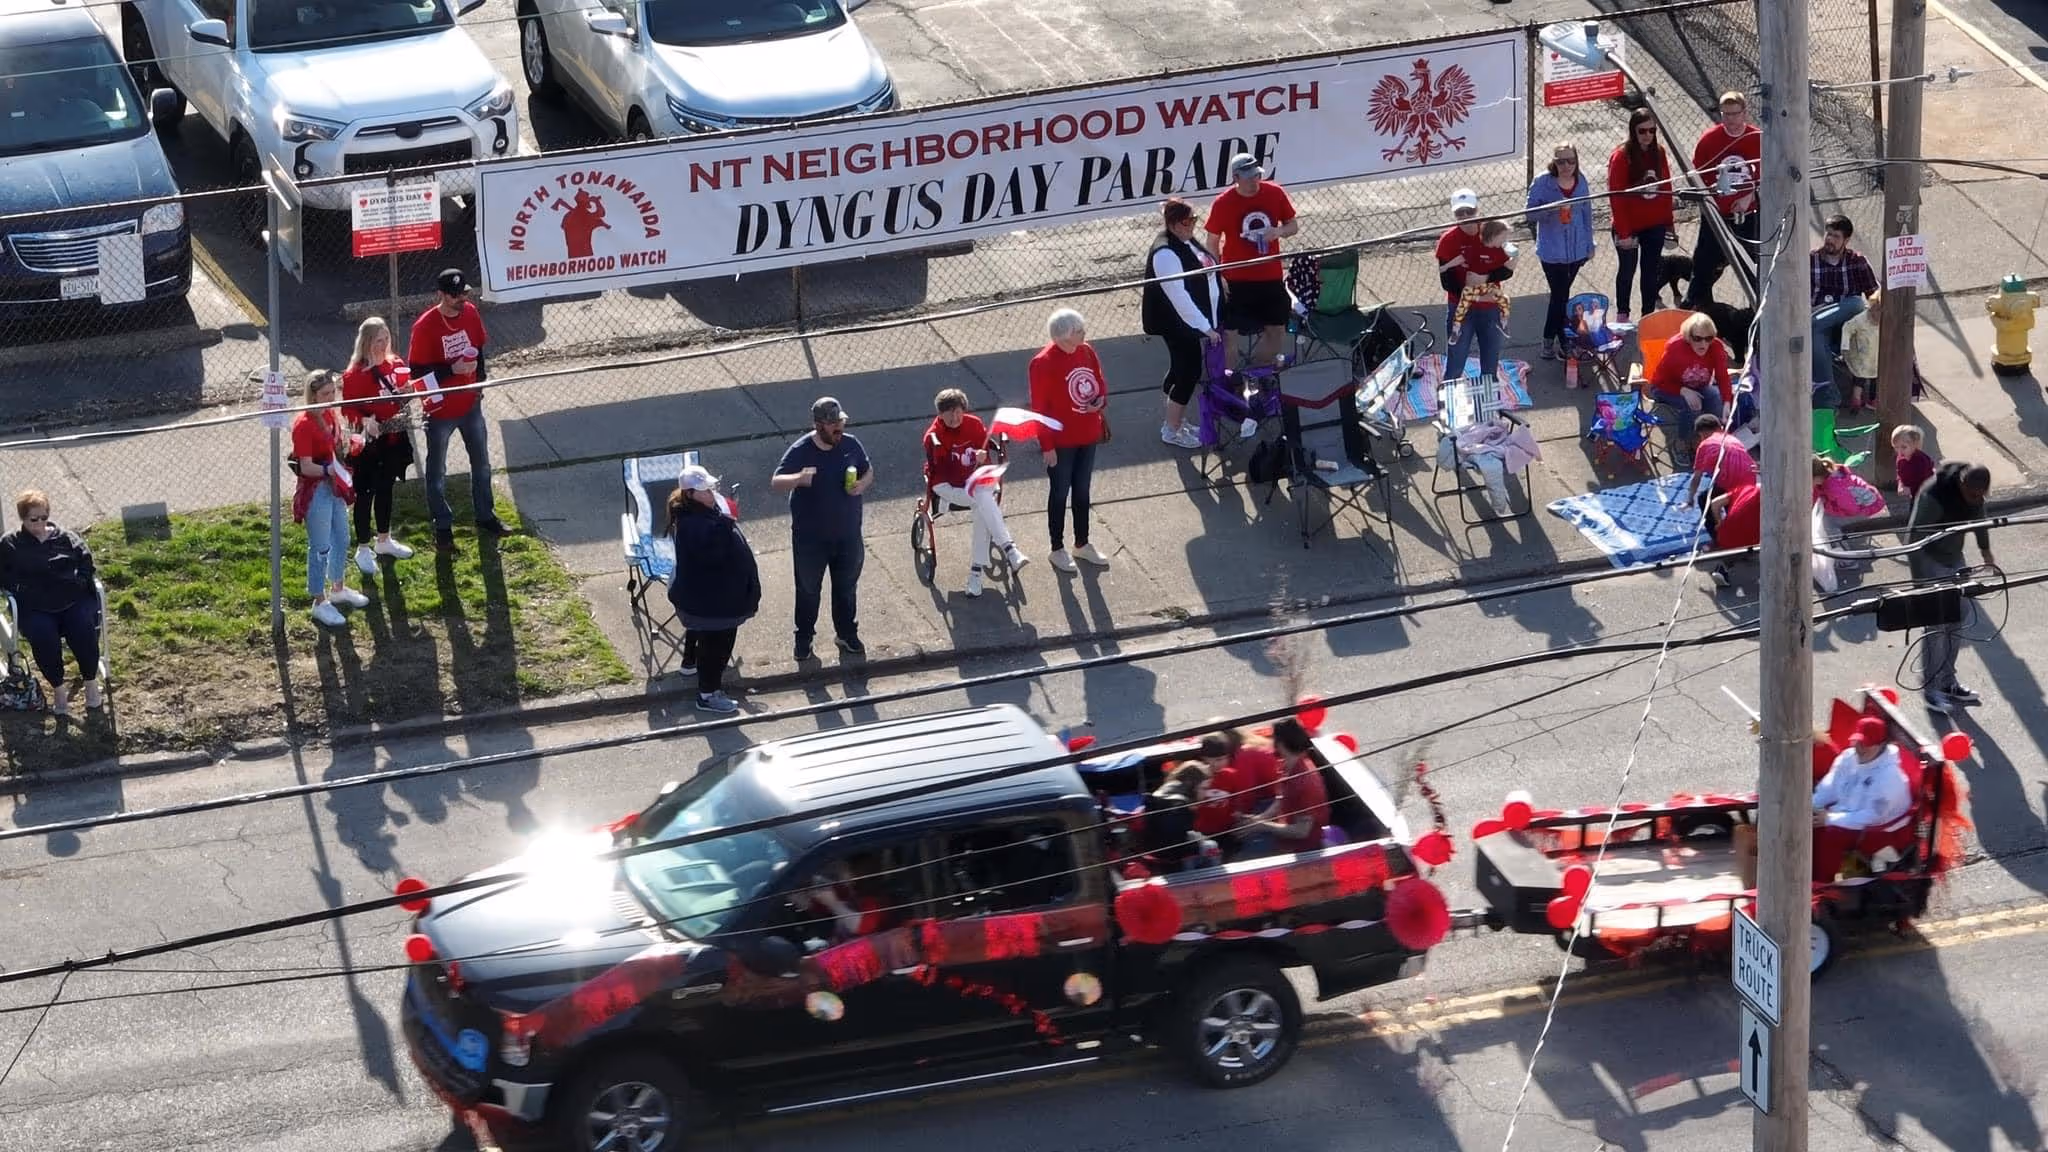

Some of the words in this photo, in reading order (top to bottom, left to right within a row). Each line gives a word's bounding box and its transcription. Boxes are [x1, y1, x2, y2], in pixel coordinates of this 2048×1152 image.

[690, 157, 752, 193] NT
[763, 106, 1146, 185] NEIGHBORHOOD
[1155, 81, 1319, 129] WATCH
[369, 194, 404, 205] DYNGUS
[508, 186, 551, 251] NORTH
[555, 170, 661, 239] TONAWANDA
[733, 179, 945, 256] DYNGUS
[959, 160, 1063, 224] DAY
[1074, 132, 1281, 207] PARADE
[506, 256, 615, 282] NEIGHBORHOOD
[620, 249, 667, 269] WATCH
[1898, 237, 1913, 246] NO
[1888, 263, 1926, 276] STANDING
[1739, 923, 1774, 977] TRUCK
[1738, 955, 1774, 1009] ROUTE
